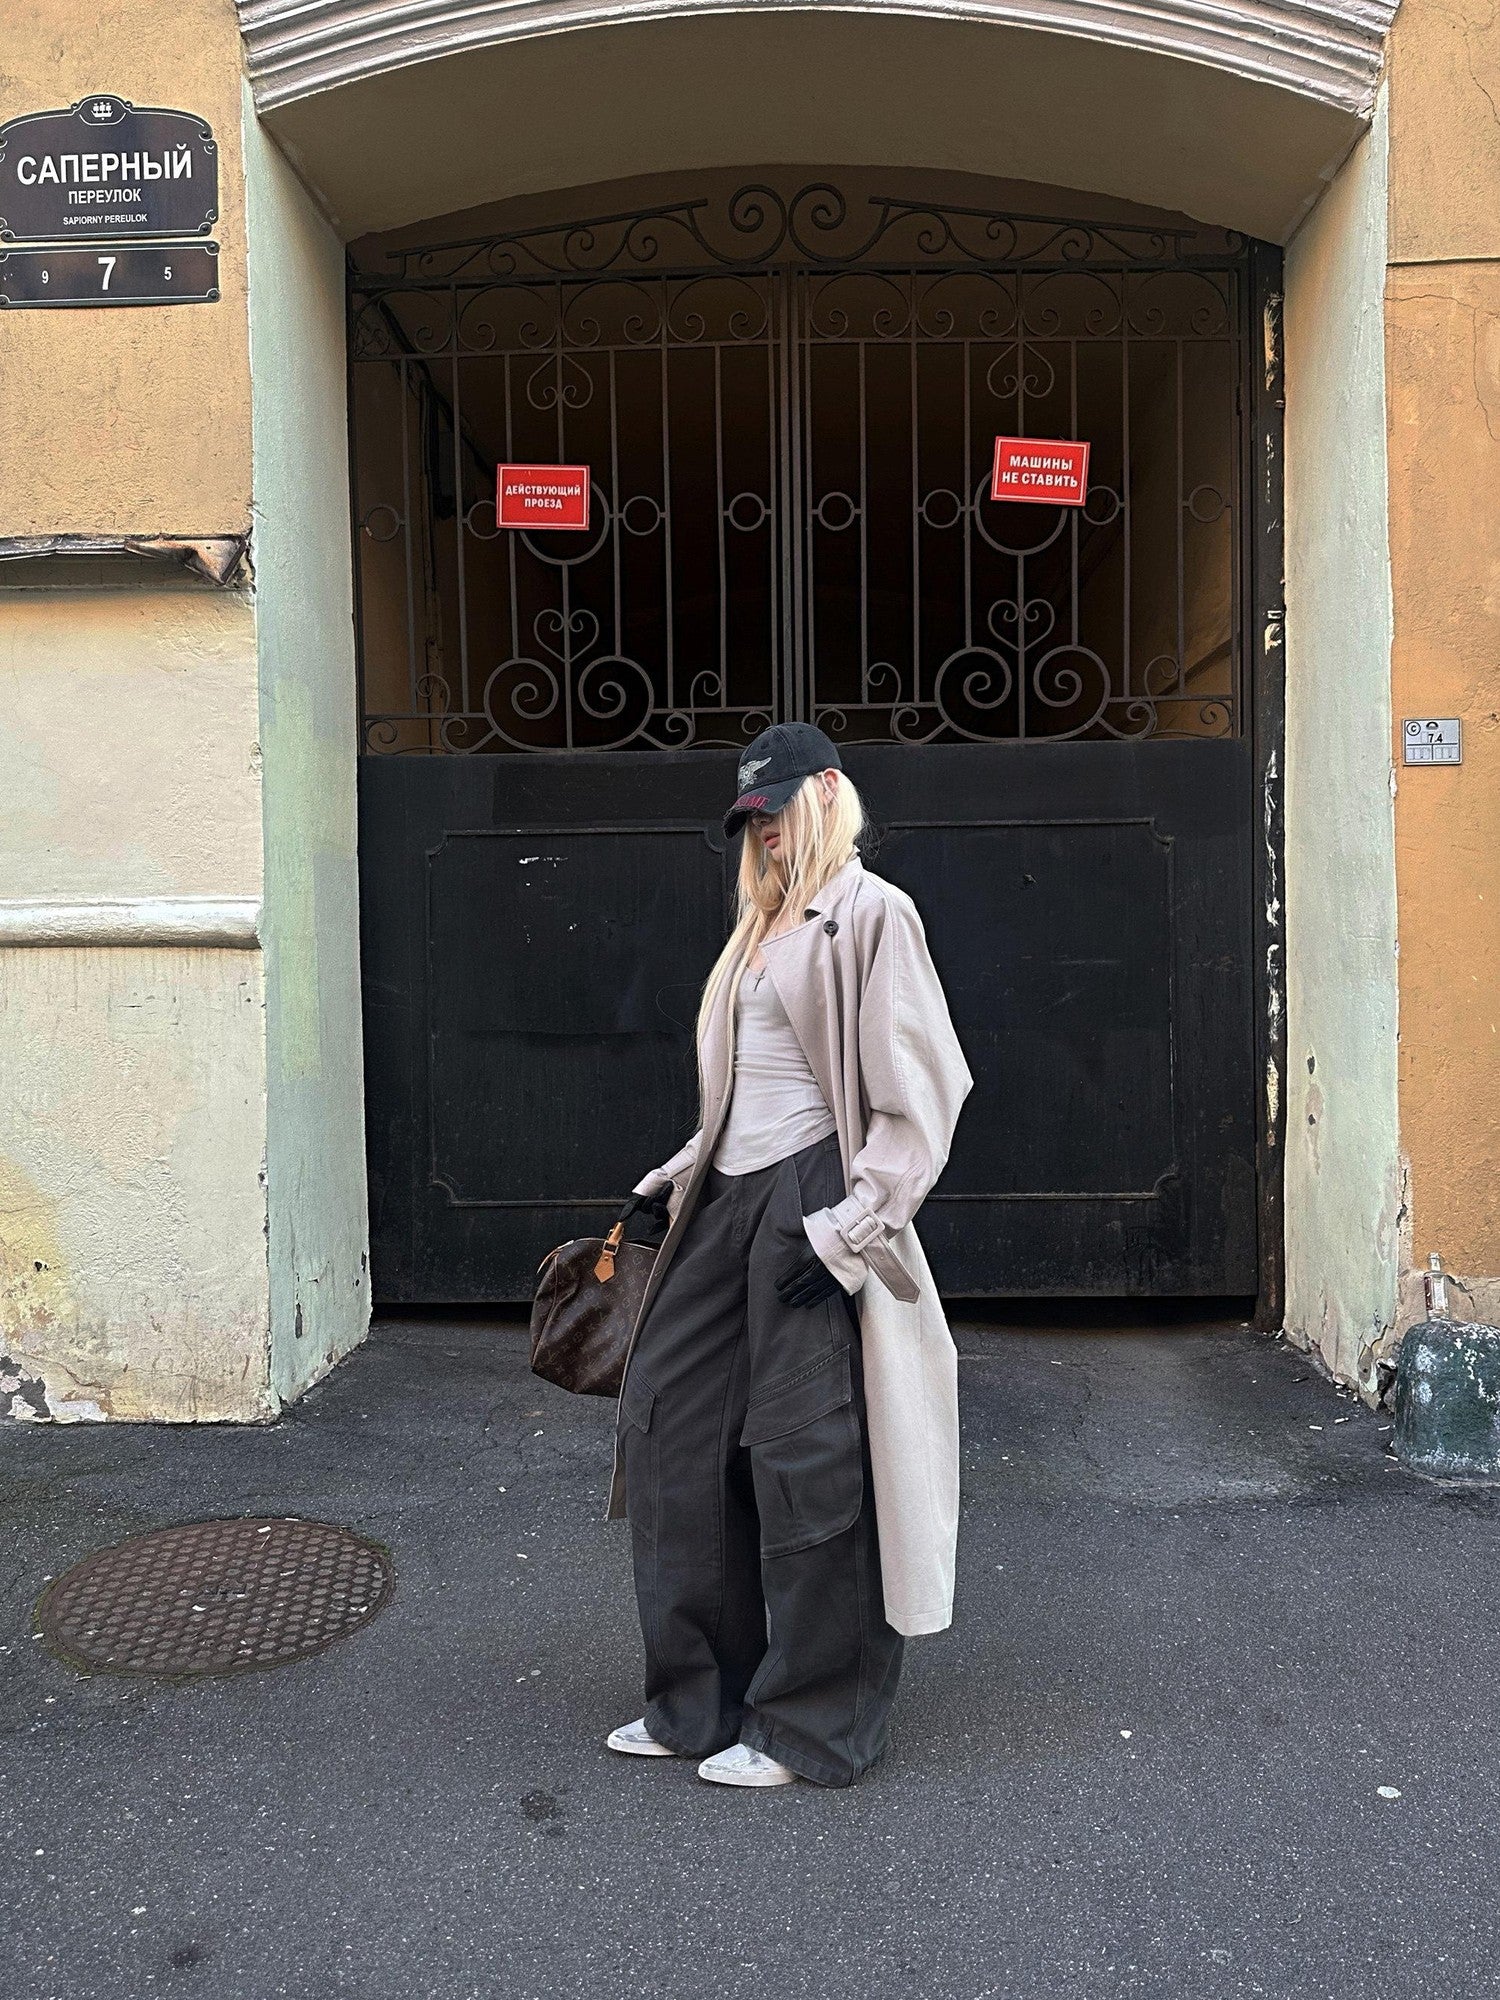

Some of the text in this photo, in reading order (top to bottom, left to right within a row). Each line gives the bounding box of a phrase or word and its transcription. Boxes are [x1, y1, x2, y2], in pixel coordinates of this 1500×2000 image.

[17, 143, 192, 185] САПЕРНЫЙ
[68, 188, 141, 204] ПЕРЕУЛОК
[63, 213, 148, 225] SAPIORNY PEREULOK
[41, 256, 172, 290] 9 7 5
[1010, 455, 1073, 470] МАШИНЫ
[1002, 471, 1078, 487] НЕ СТАВИТЬ
[505, 484, 580, 497] ДЕЙСТВУЮЩИЙ
[524, 498, 562, 509] ПРОЕЗД
